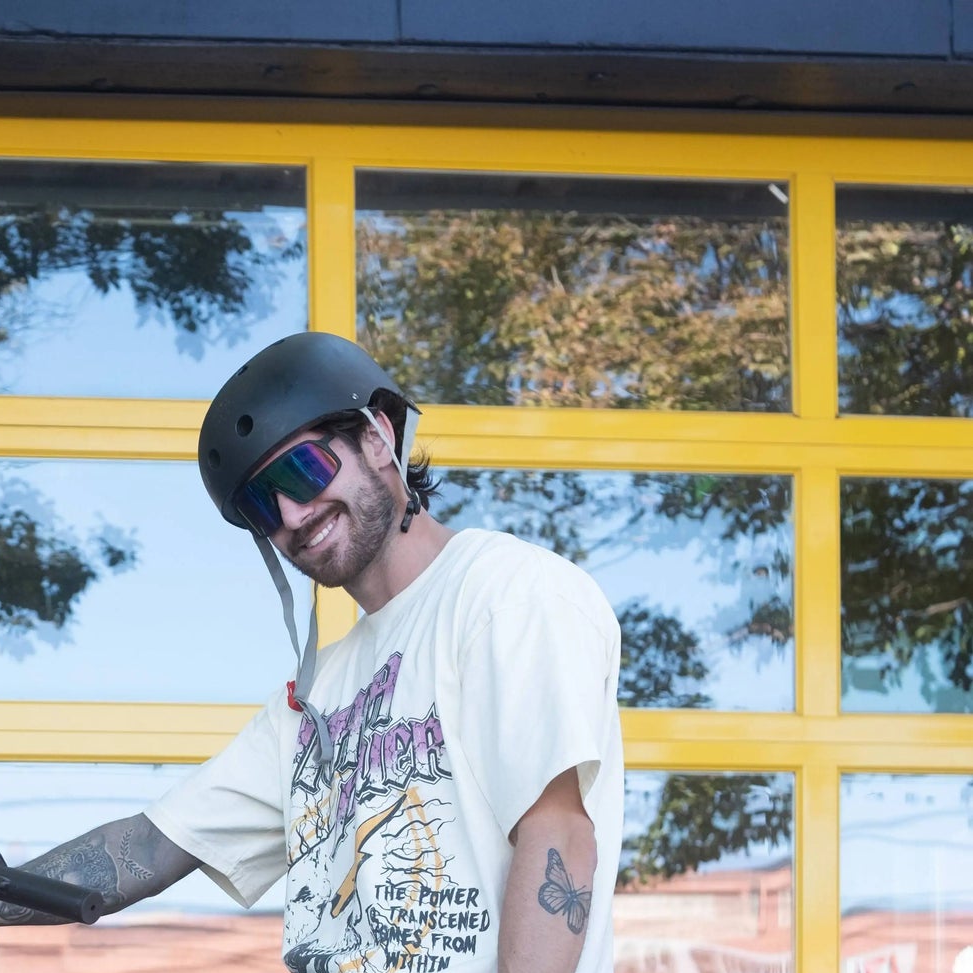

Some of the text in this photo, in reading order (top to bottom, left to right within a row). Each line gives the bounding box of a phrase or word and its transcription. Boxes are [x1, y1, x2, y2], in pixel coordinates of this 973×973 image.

[375, 885, 480, 908] THE POWER
[390, 906, 490, 932] TRANSCENED
[431, 934, 477, 955] FROM
[386, 952, 451, 973] WITHIN
